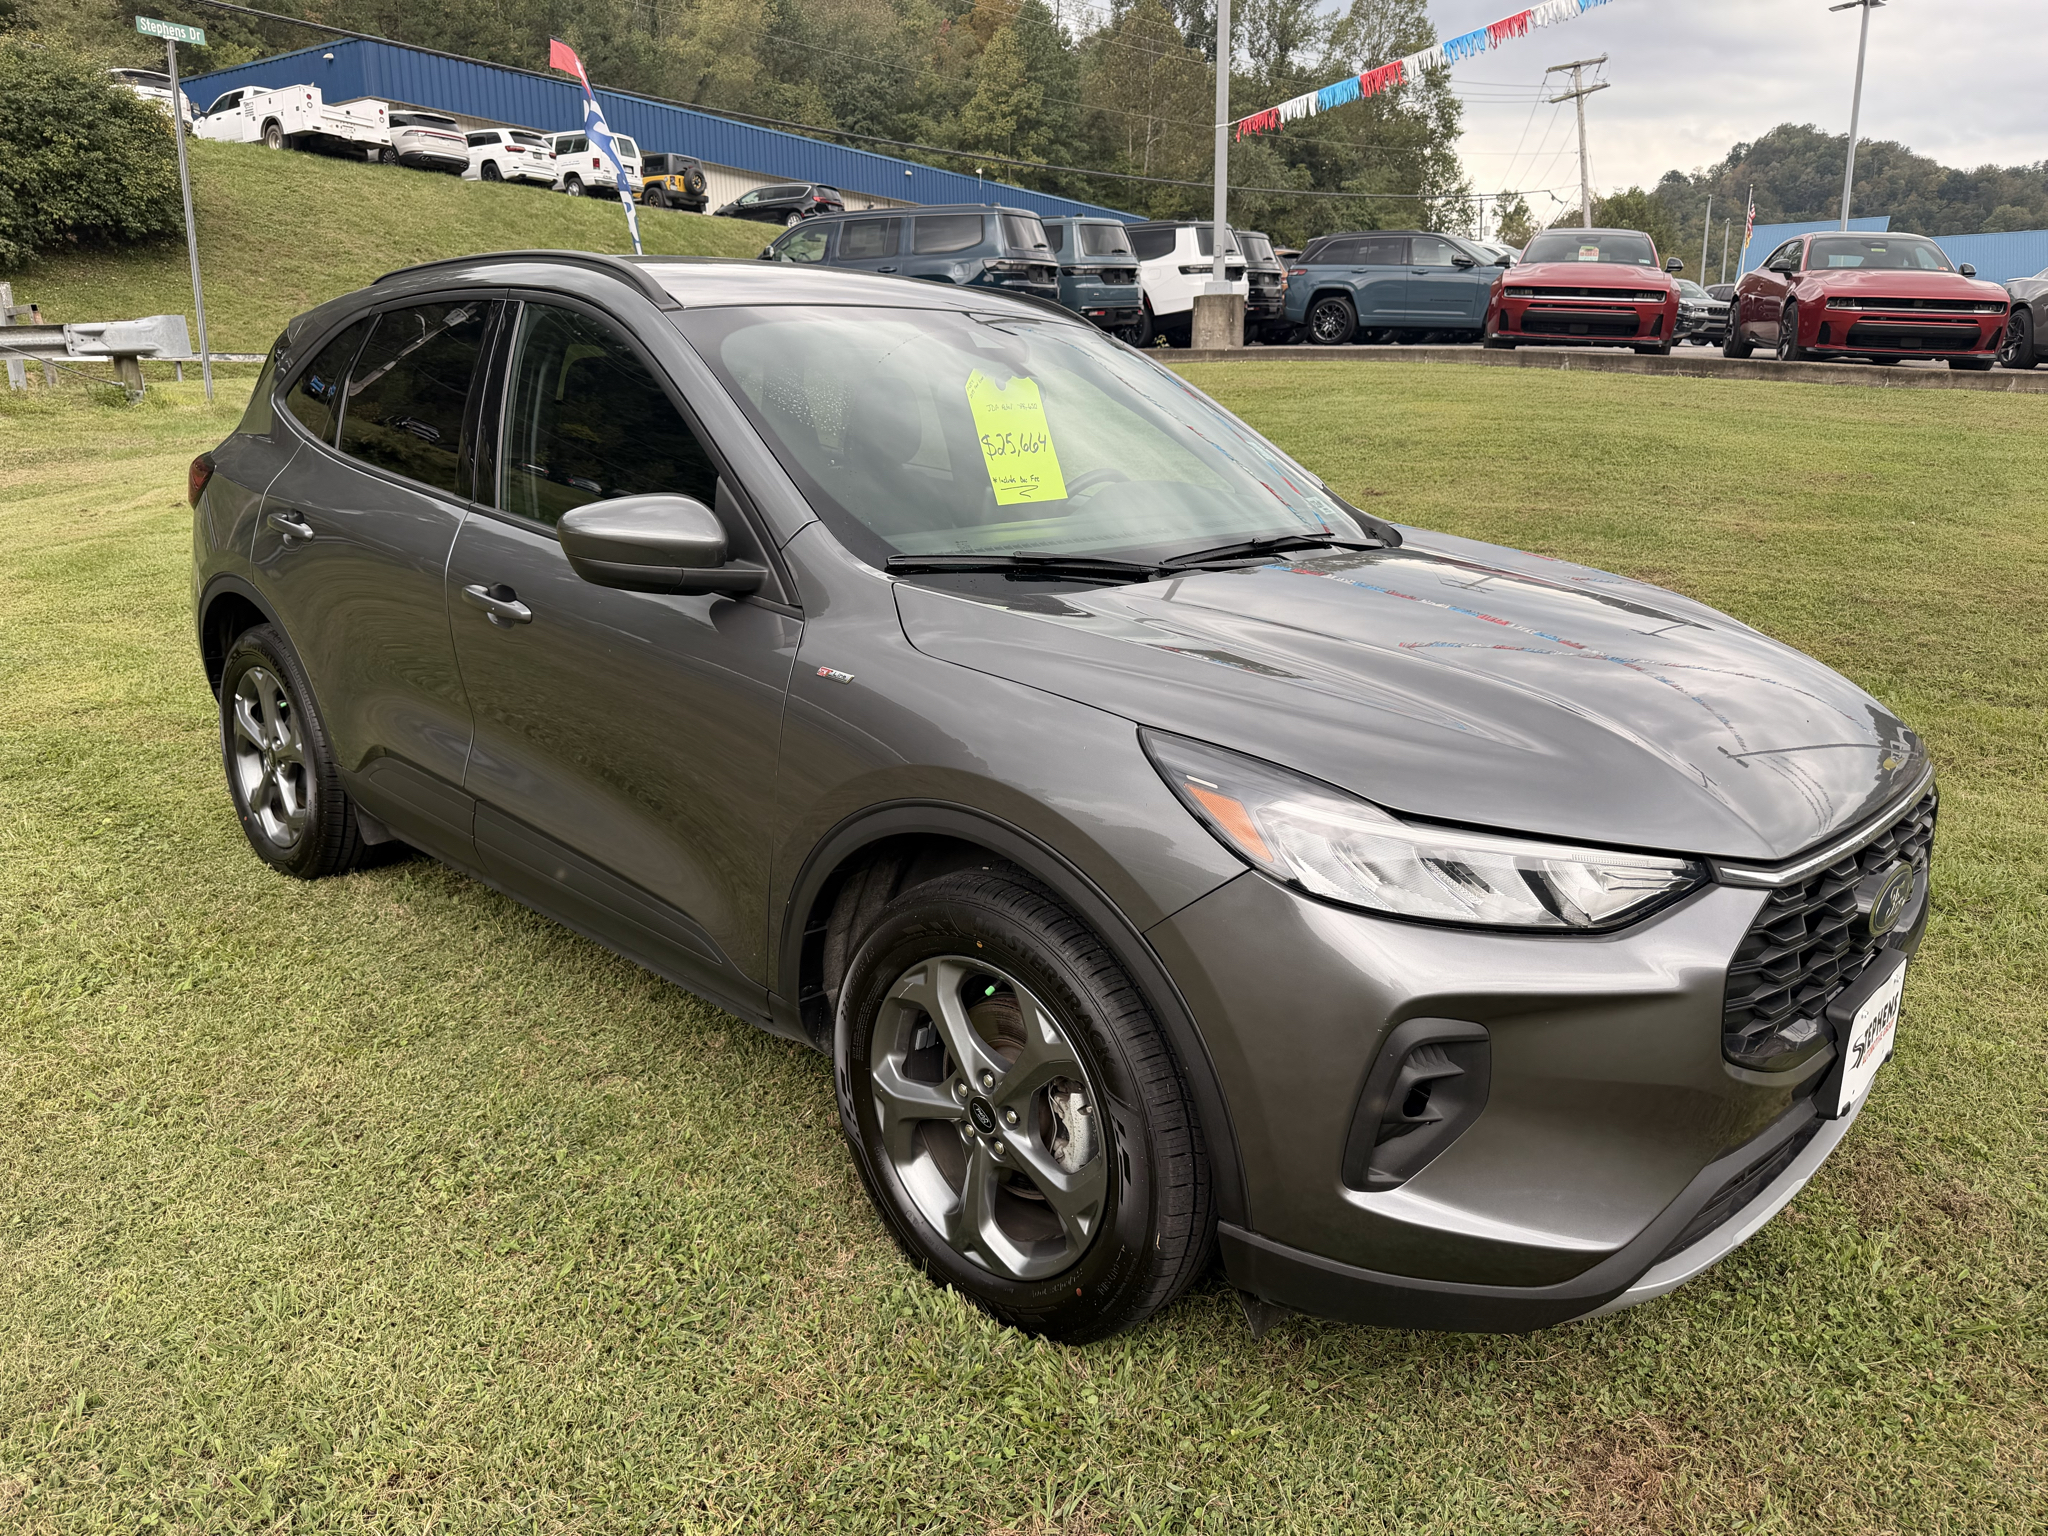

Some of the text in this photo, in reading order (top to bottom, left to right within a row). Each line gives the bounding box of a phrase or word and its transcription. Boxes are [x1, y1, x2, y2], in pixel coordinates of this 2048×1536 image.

[140, 17, 201, 41] Stephens Dr
[980, 432, 1047, 461] $25,664
[1029, 474, 1041, 483] Fee
[973, 916, 1117, 1071] MASTERTRACK
[1847, 990, 1900, 1073] STEPHENS
